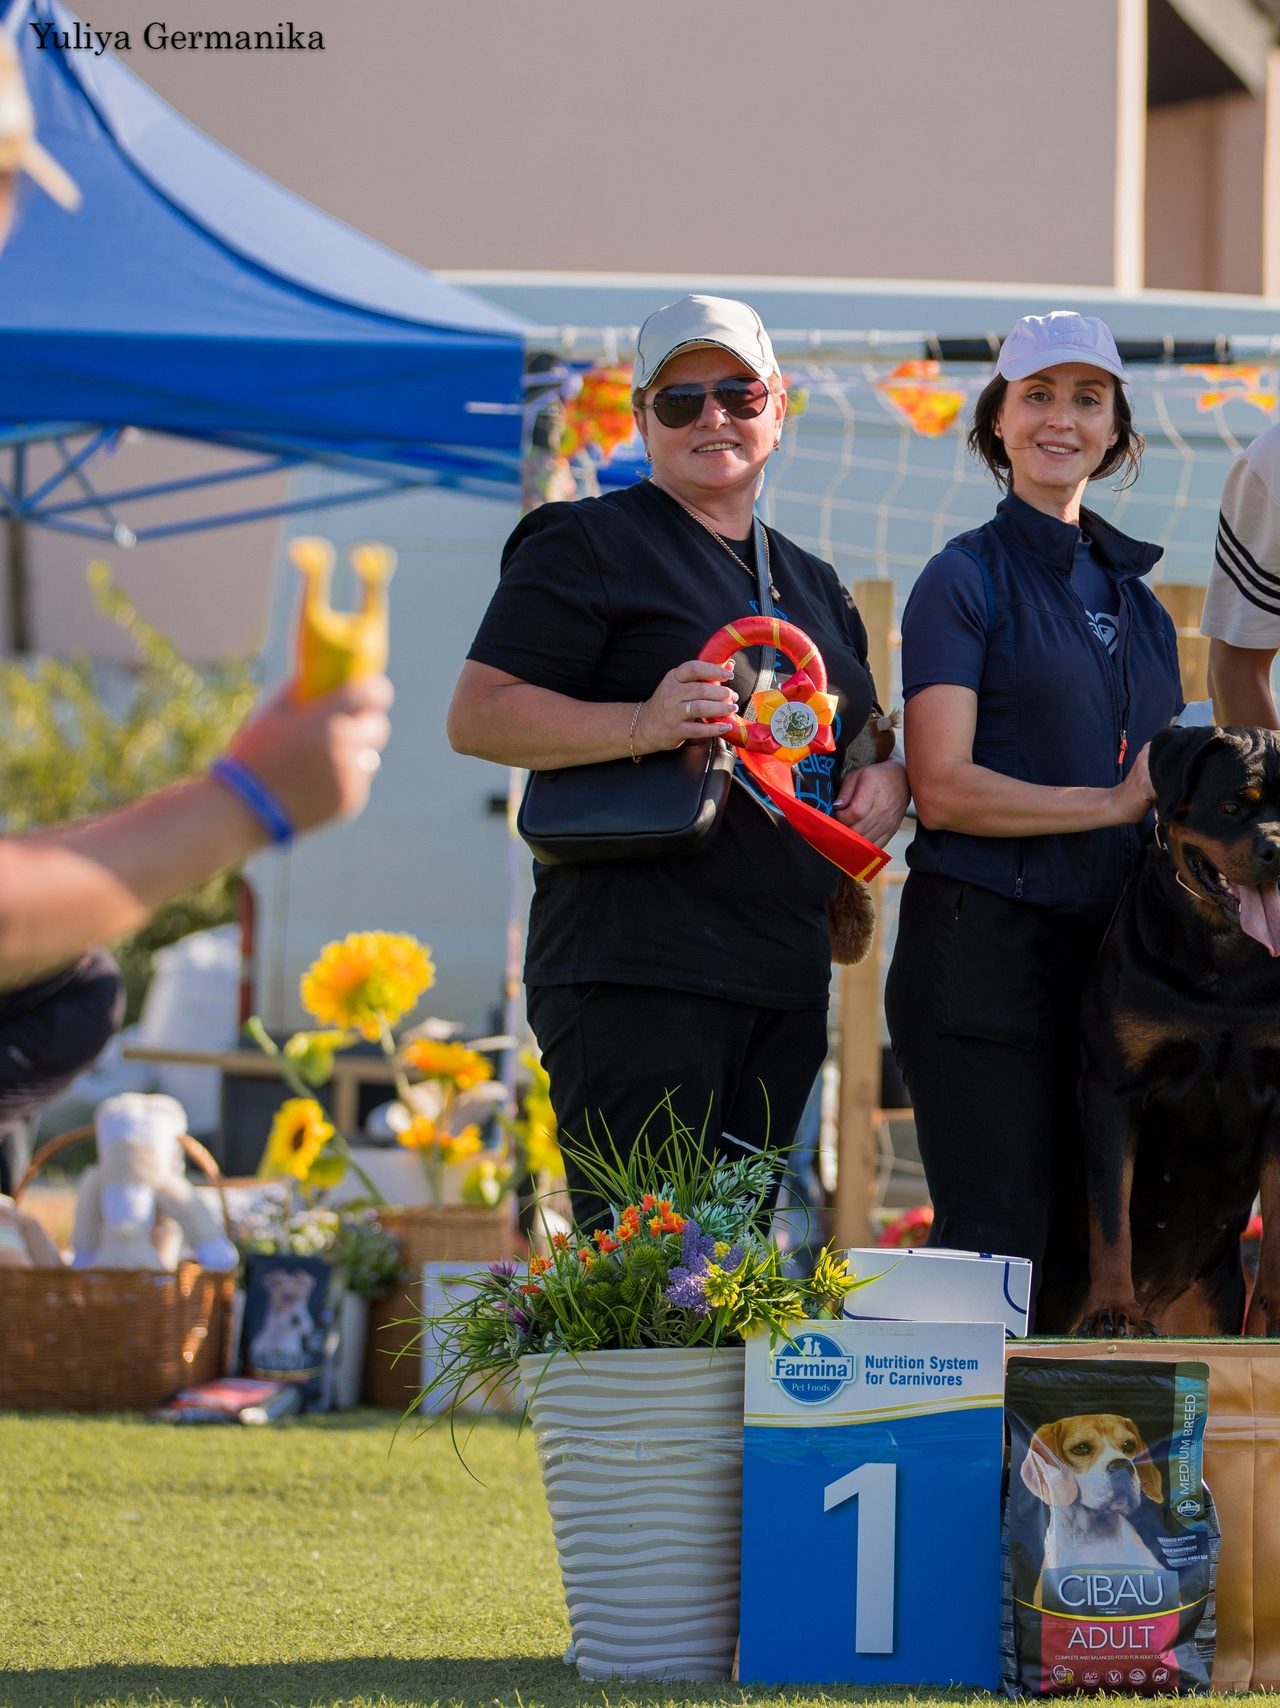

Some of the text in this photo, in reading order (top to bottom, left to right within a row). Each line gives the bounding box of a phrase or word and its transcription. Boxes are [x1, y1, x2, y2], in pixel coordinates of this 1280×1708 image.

[776, 1358, 848, 1377] Farmina
[865, 1355, 979, 1372] Nutrition System
[792, 1383, 831, 1392] Pet Foods
[865, 1371, 963, 1386] for Carnivores
[1179, 1394, 1196, 1495] MEDIUM BREED
[824, 1463, 897, 1654] 1
[1058, 1574, 1164, 1607] CIBAU
[1067, 1625, 1156, 1649] ADULT
